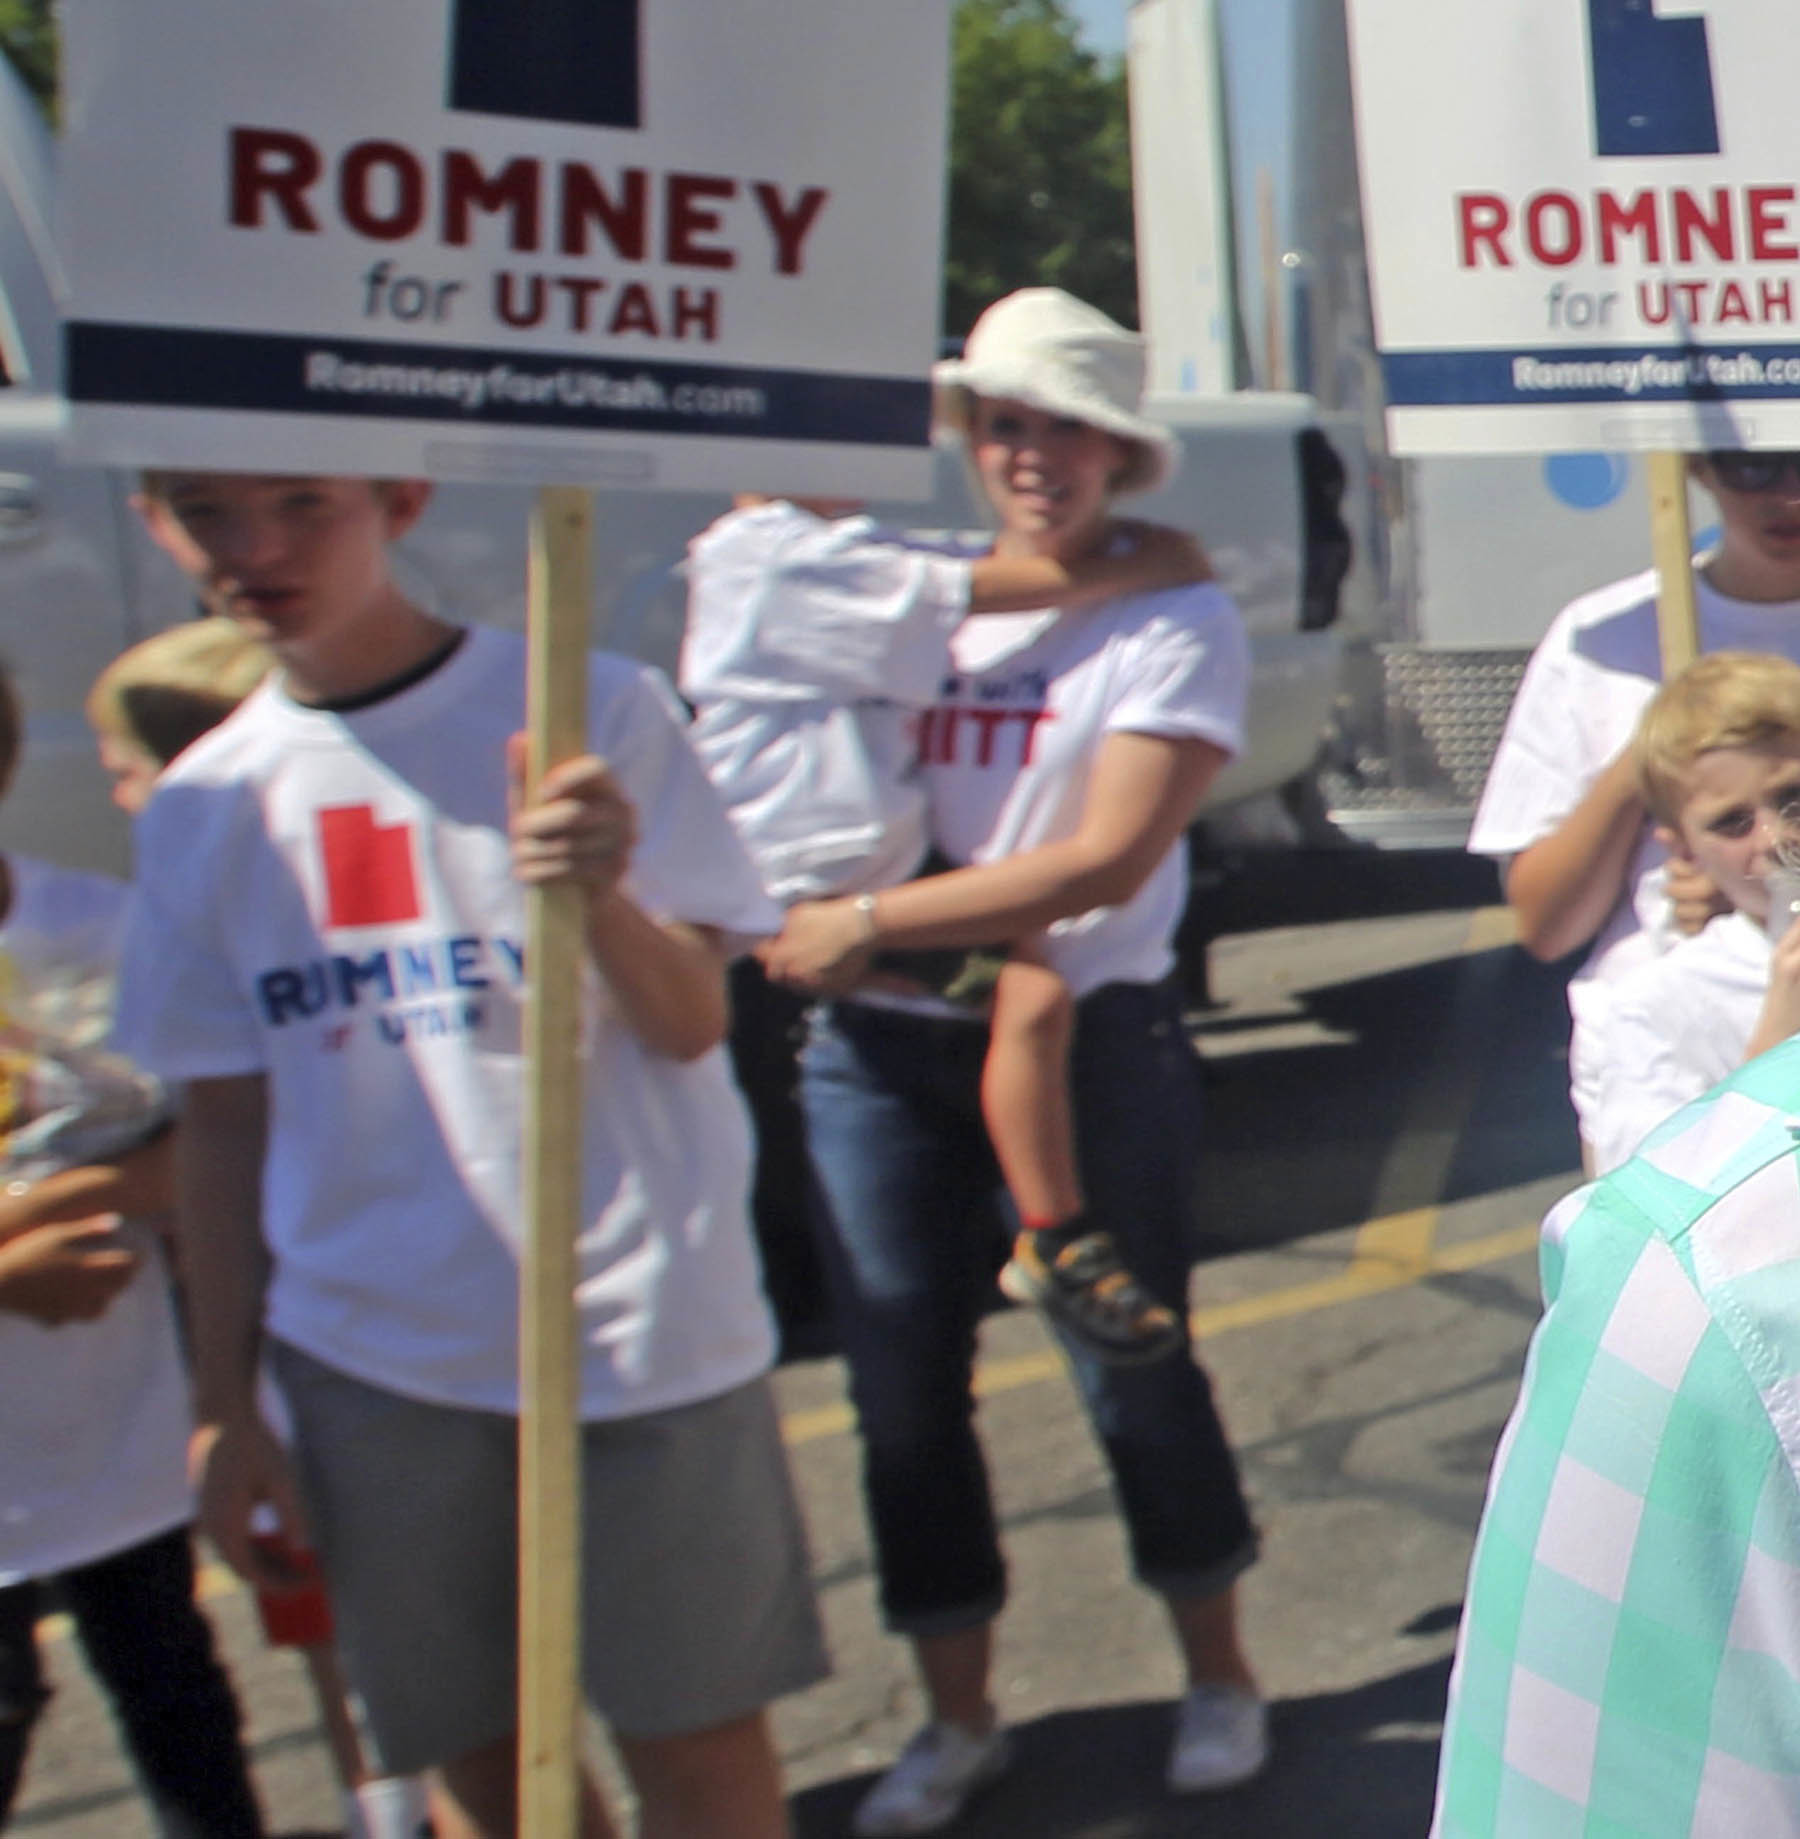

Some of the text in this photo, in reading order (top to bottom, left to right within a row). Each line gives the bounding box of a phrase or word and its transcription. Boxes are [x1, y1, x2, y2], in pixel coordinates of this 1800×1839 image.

[226, 125, 828, 276] ROMNEY
[361, 261, 721, 342] for UTAH
[1545, 279, 1795, 331] for UTAH
[304, 354, 764, 418] RomneyforUtah.com
